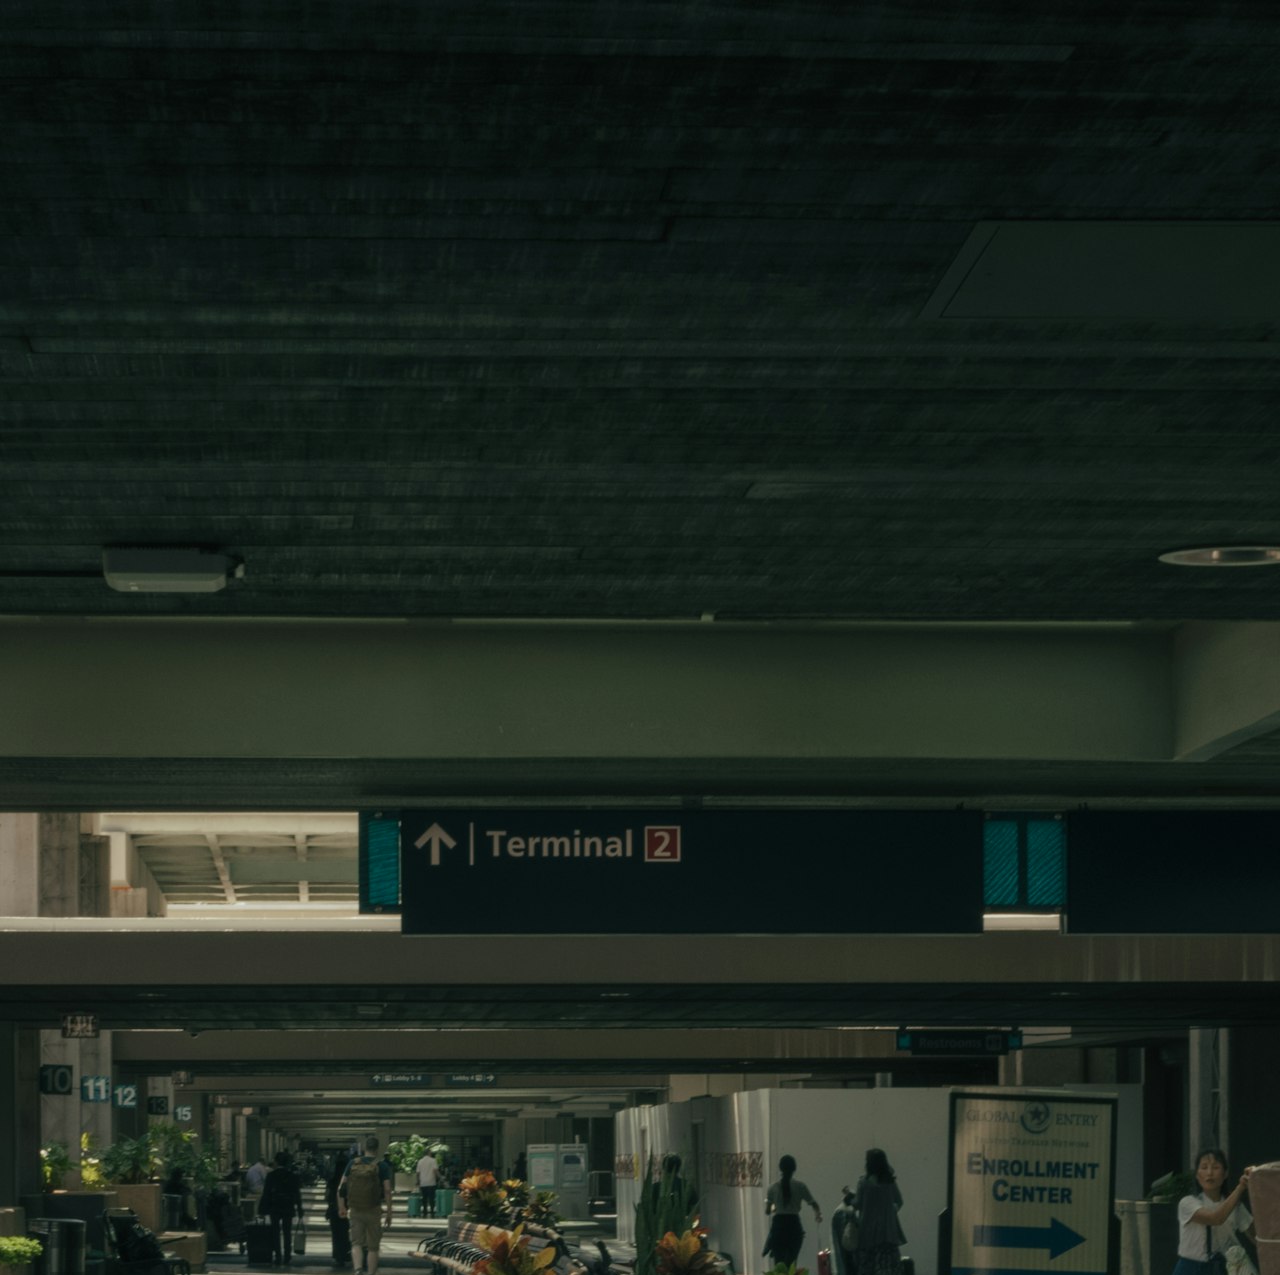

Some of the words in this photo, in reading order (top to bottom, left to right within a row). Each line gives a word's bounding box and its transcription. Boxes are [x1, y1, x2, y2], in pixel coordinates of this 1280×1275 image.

[485, 829, 633, 857] Terminal
[653, 831, 672, 857] 2
[919, 1037, 983, 1049] Restrooms
[42, 1068, 72, 1092] 10
[83, 1079, 107, 1100] 11
[114, 1087, 136, 1106] 12
[150, 1098, 167, 1114] 13
[175, 1107, 192, 1121] 15
[966, 1109, 1019, 1124] GLOBAL
[1056, 1113, 1099, 1127] ENTRY
[967, 1153, 1099, 1180] ENROLLMENT
[992, 1178, 1073, 1204] CENTER
